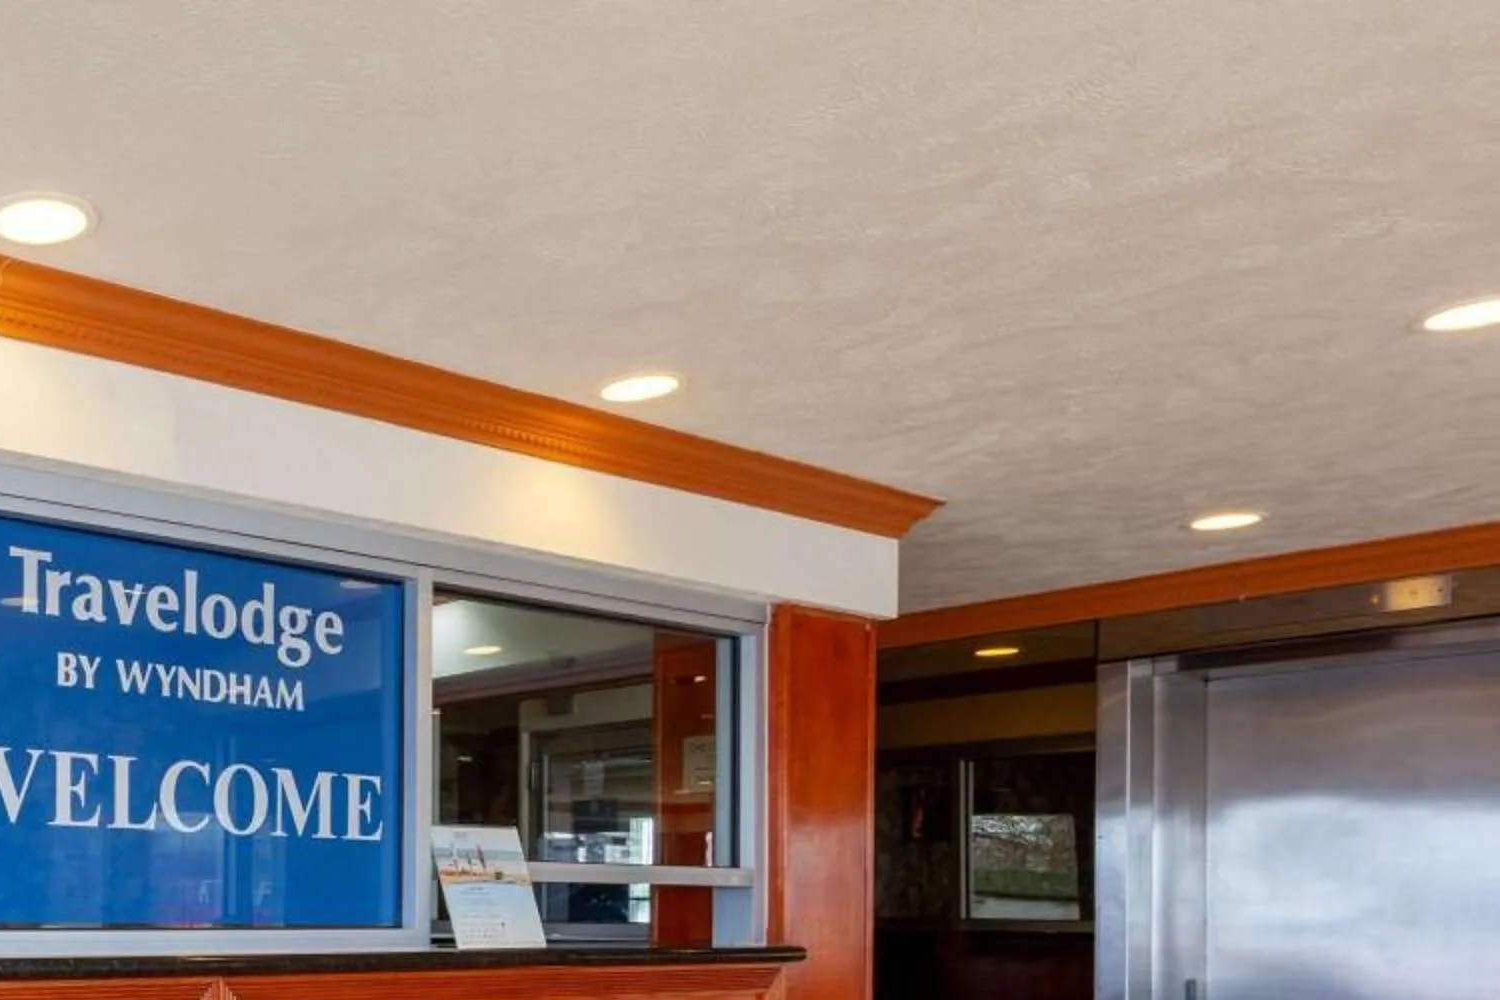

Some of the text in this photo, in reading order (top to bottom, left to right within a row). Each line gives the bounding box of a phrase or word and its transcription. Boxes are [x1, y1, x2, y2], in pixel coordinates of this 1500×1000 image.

[9, 547, 344, 666] Travelodge
[57, 652, 305, 711] BY WYNDHAM
